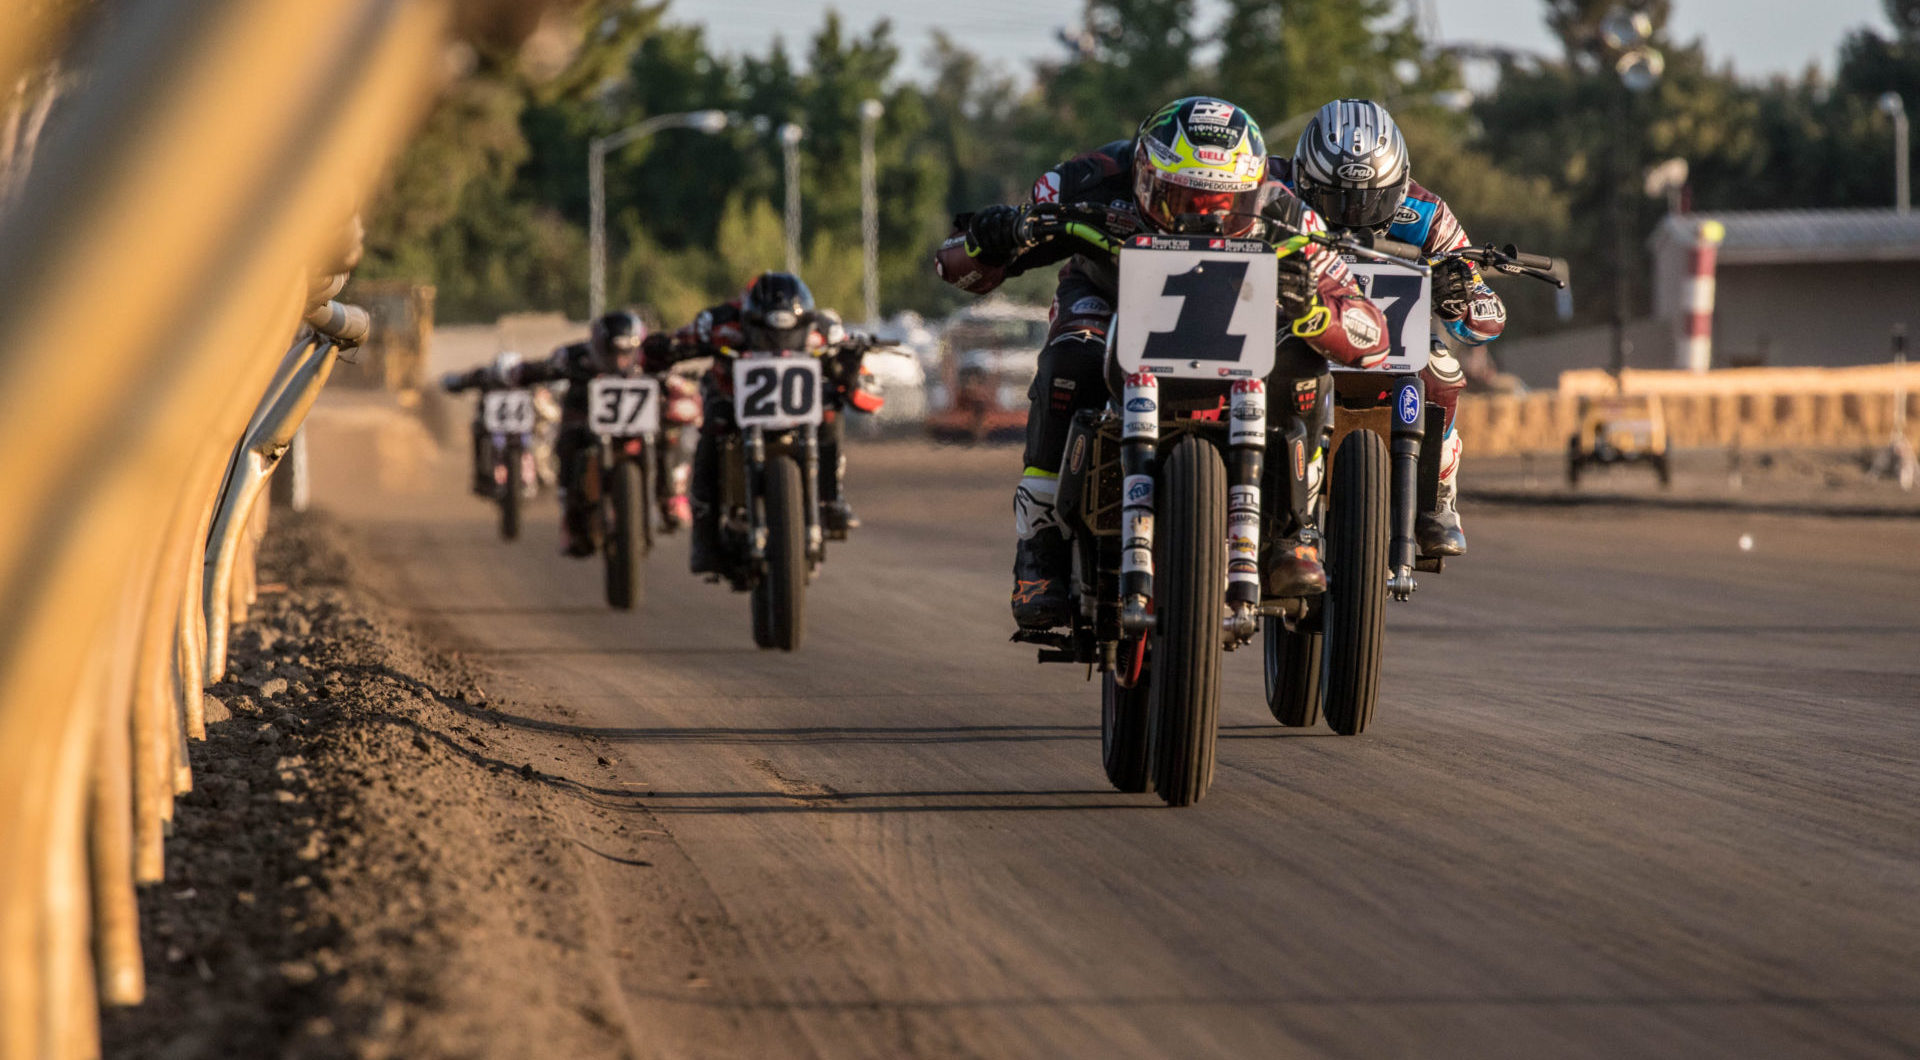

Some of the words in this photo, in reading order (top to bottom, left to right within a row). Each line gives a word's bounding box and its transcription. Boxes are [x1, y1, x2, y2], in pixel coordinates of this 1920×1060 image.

[1199, 151, 1226, 162] BELL
[1341, 164, 1372, 178] Arai
[1396, 211, 1414, 220] rai
[1141, 260, 1250, 362] 1
[1354, 274, 1423, 357] 7
[1126, 373, 1156, 389] RK
[1233, 379, 1263, 394] RK
[743, 367, 814, 417] 20
[597, 387, 650, 424] 37
